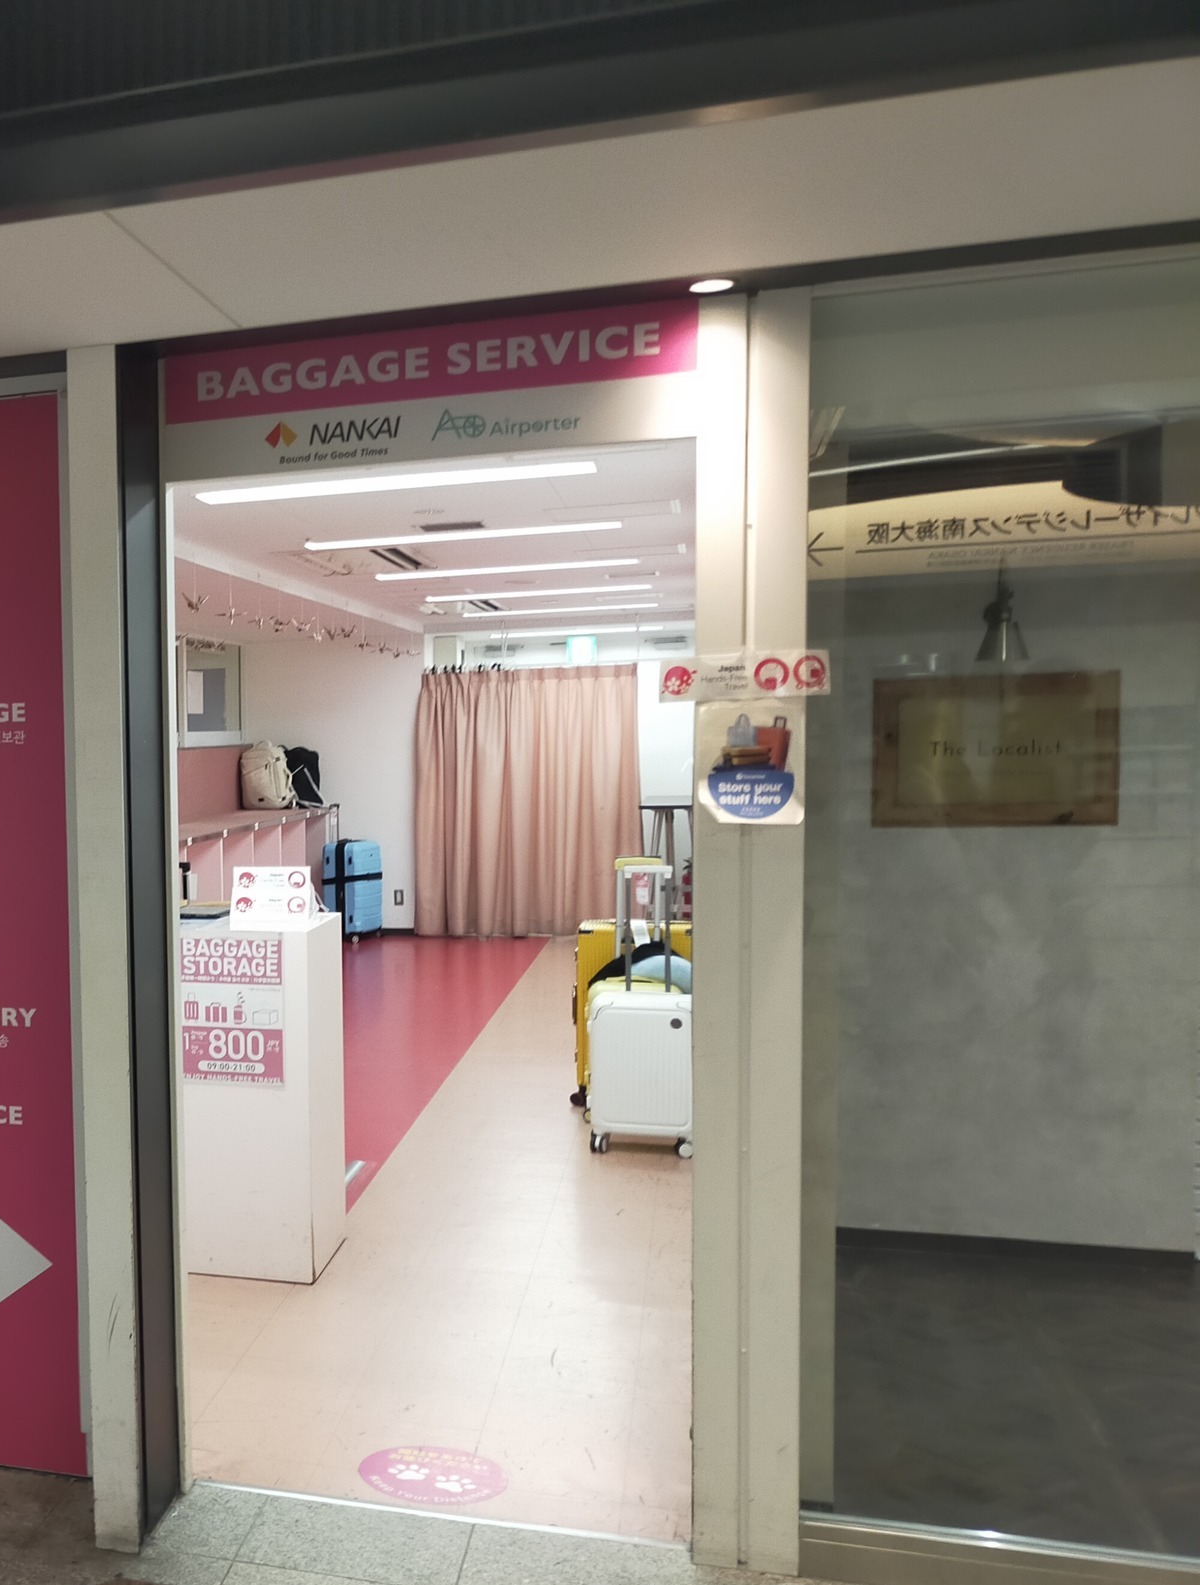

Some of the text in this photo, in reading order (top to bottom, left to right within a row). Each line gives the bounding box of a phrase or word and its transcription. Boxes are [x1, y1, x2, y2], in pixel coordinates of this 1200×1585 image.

[197, 322, 661, 402] BAGGAGE SERVICE
[309, 415, 401, 446] NANKAI
[489, 416, 581, 437] Airporter
[279, 447, 388, 465] Bound for Good Times
[929, 738, 1061, 757] The Localist
[718, 782, 783, 797] Store your
[719, 793, 782, 805] stuff here
[182, 938, 278, 958] BAGGAGE
[183, 956, 278, 977] STORAGE
[208, 1029, 264, 1061] 800
[207, 1062, 256, 1072] 09:00-21:00
[369, 1475, 394, 1491] Keep
[398, 1489, 429, 1501] Your
